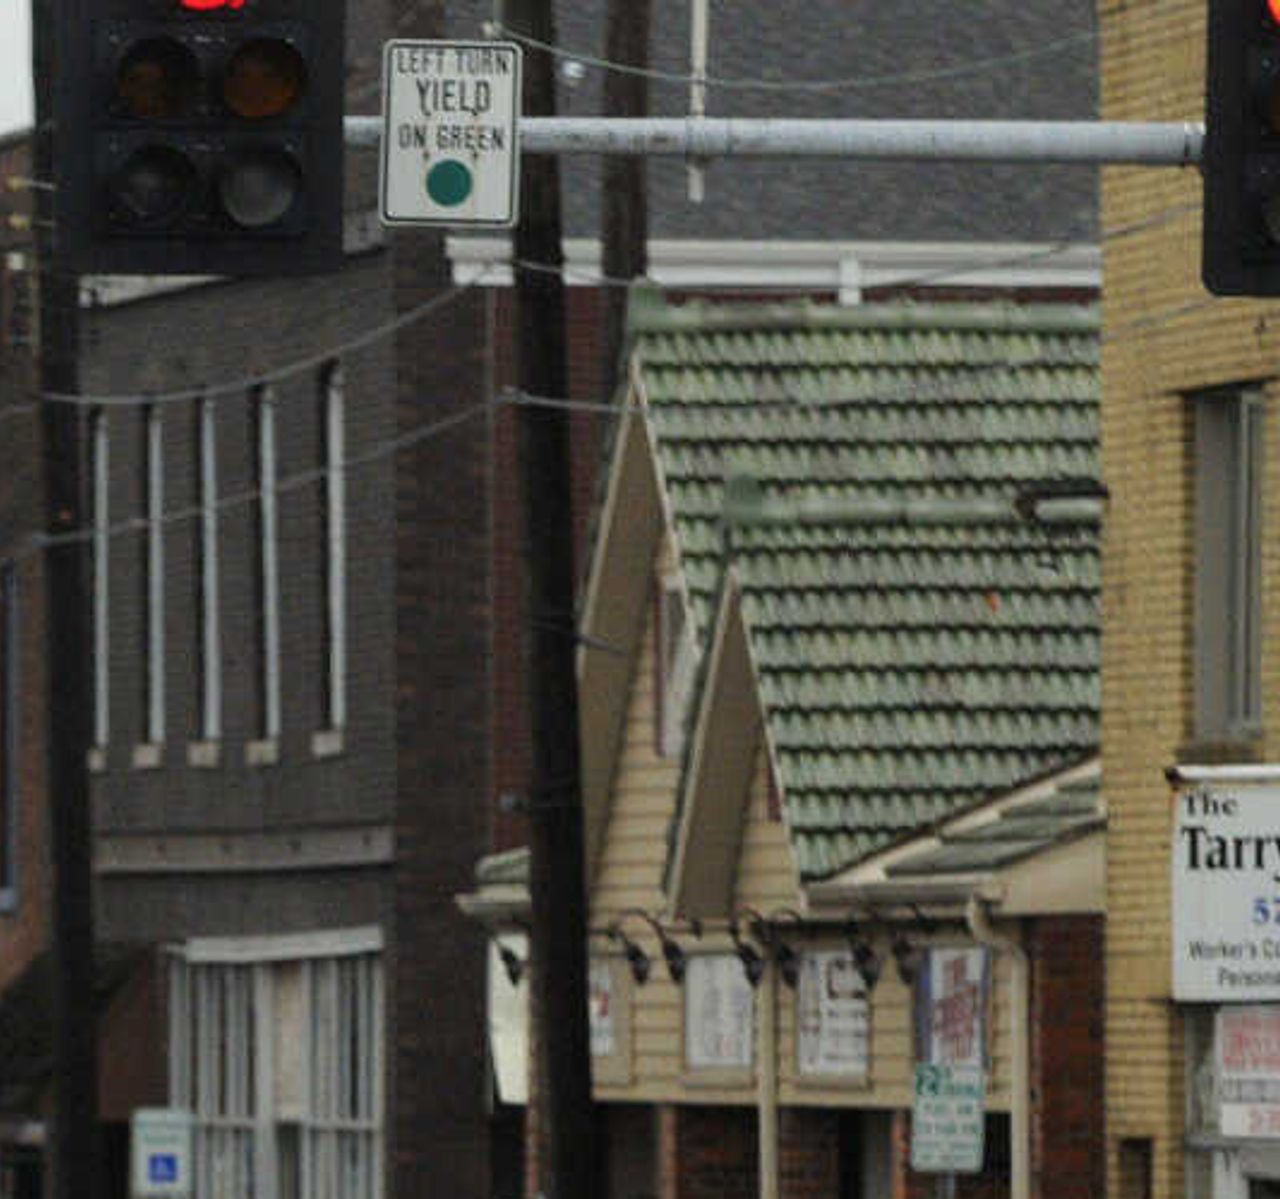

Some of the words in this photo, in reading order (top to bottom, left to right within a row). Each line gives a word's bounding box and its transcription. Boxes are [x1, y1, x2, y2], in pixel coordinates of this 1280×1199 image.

[397, 50, 444, 75] LEFT
[455, 51, 510, 75] TURN
[416, 79, 490, 115] YIELD
[398, 123, 426, 149] ON
[437, 125, 506, 151] GREEN
[1183, 788, 1238, 816] The
